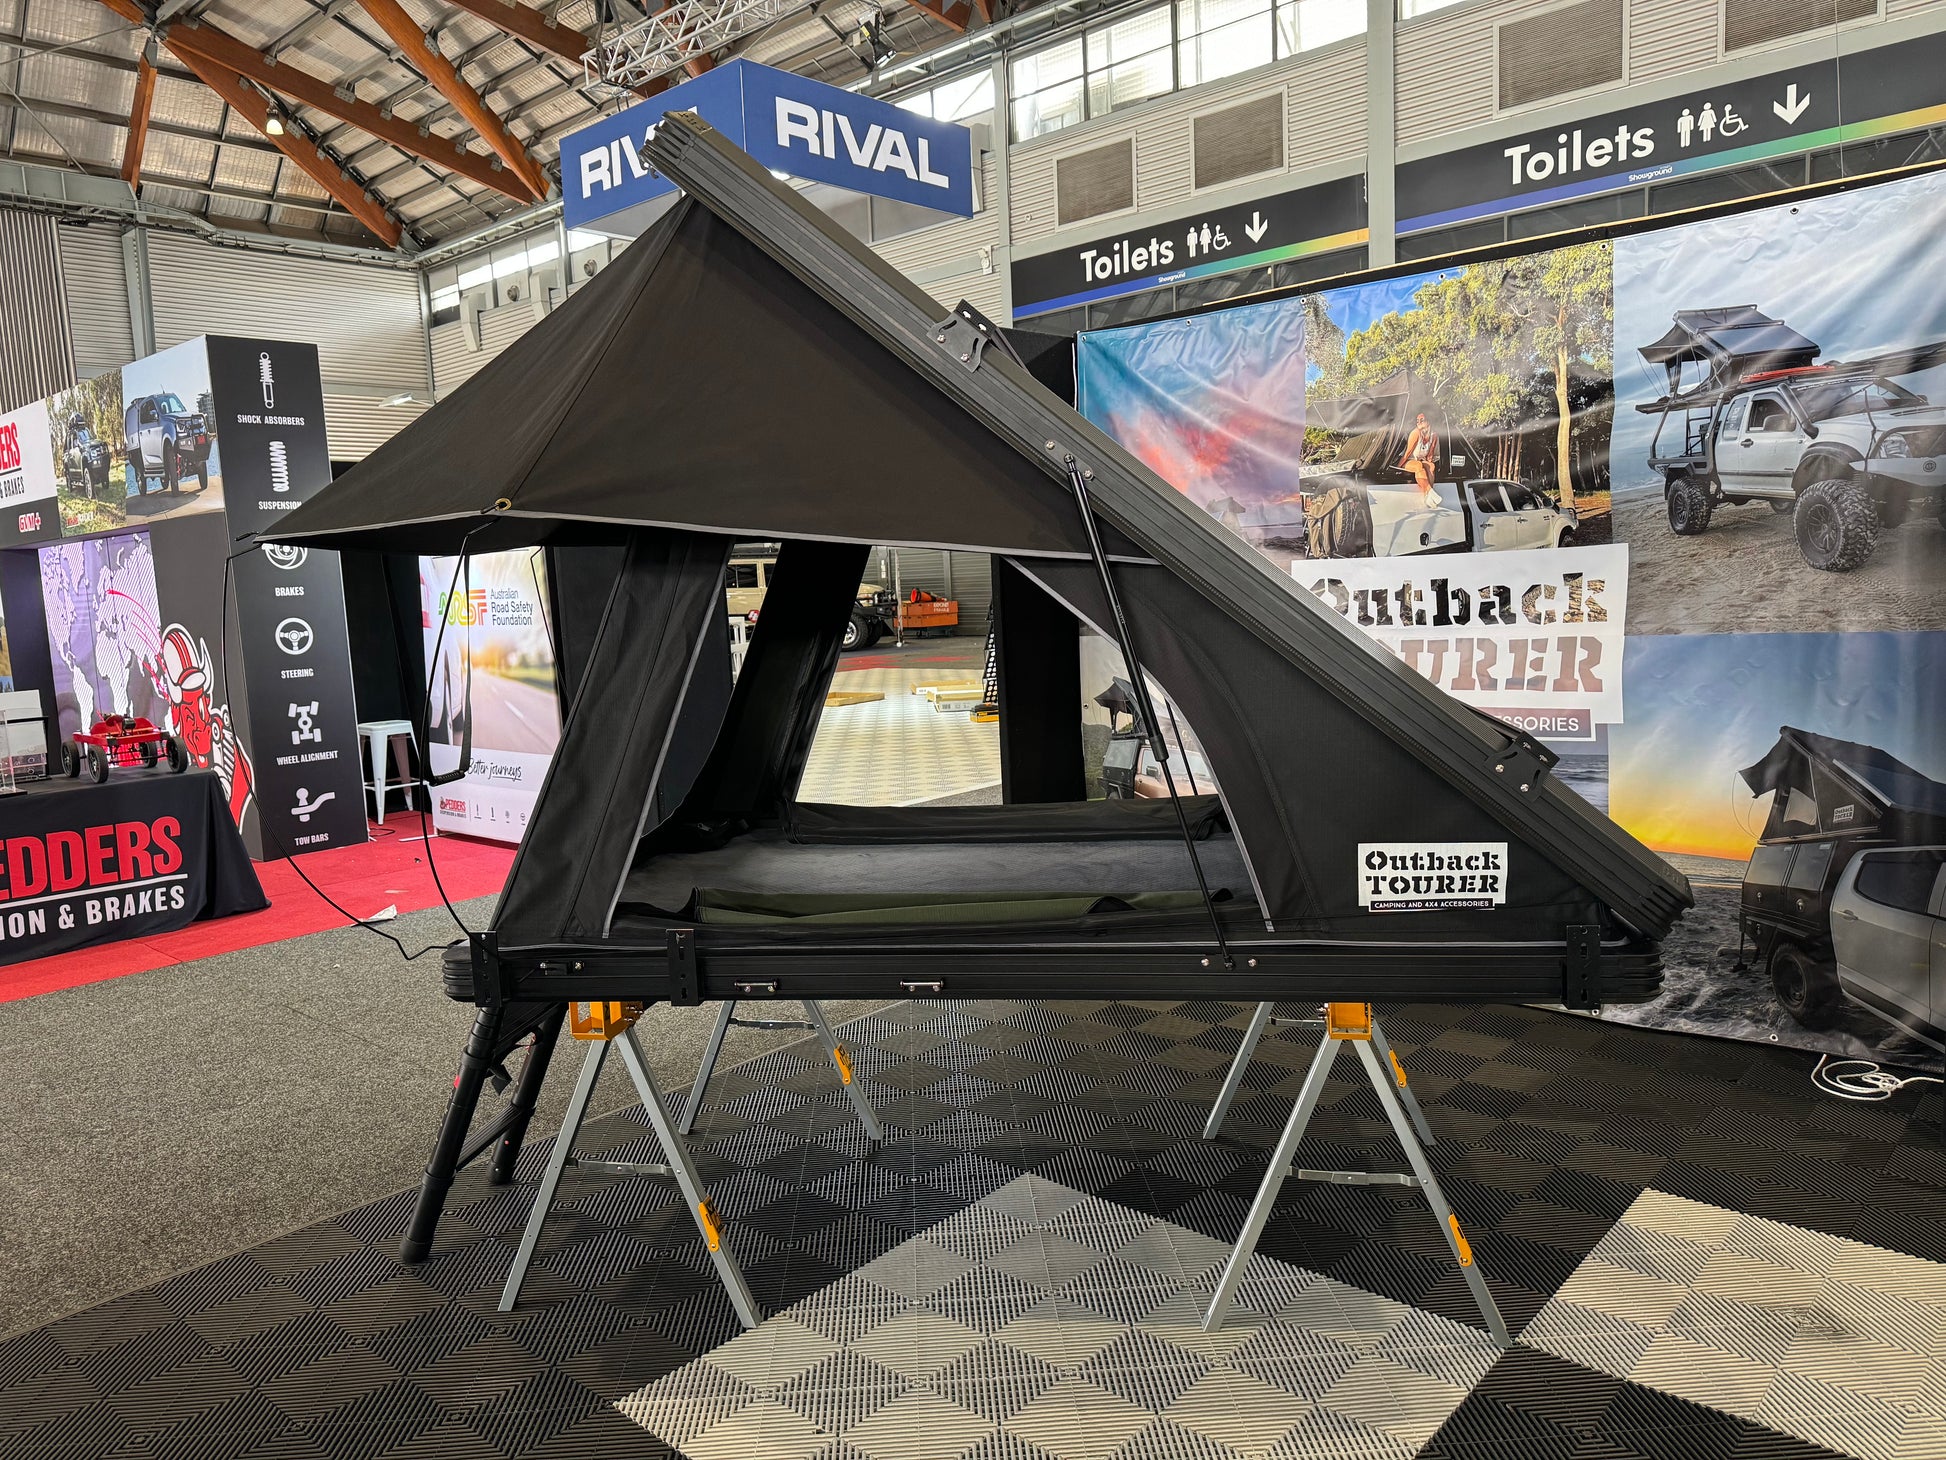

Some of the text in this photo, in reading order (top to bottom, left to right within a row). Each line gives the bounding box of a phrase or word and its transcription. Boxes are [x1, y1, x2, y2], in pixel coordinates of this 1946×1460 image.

[775, 95, 950, 188] RIVAL
[580, 105, 698, 199] RIV
[1504, 124, 1655, 185] Toilets
[1628, 166, 1673, 182] Showground
[1080, 237, 1175, 282] Toilets
[237, 414, 305, 426] SHOCK ABSORBERS
[275, 586, 305, 597] BRAKES
[490, 588, 519, 600] Australian
[1310, 571, 1608, 627] Outback
[491, 600, 533, 615] Road Safety
[492, 614, 532, 626] Foundation
[281, 668, 314, 679] STEERING
[1378, 636, 1603, 692] URER
[276, 750, 339, 766] WHEEL ALIGNMENT
[294, 833, 329, 846] TOW BARS
[0, 816, 183, 901] DDERS
[1365, 850, 1501, 871] Outback
[1365, 875, 1499, 895] TOURER
[58, 904, 75, 929] &
[85, 885, 186, 925] BRAKES
